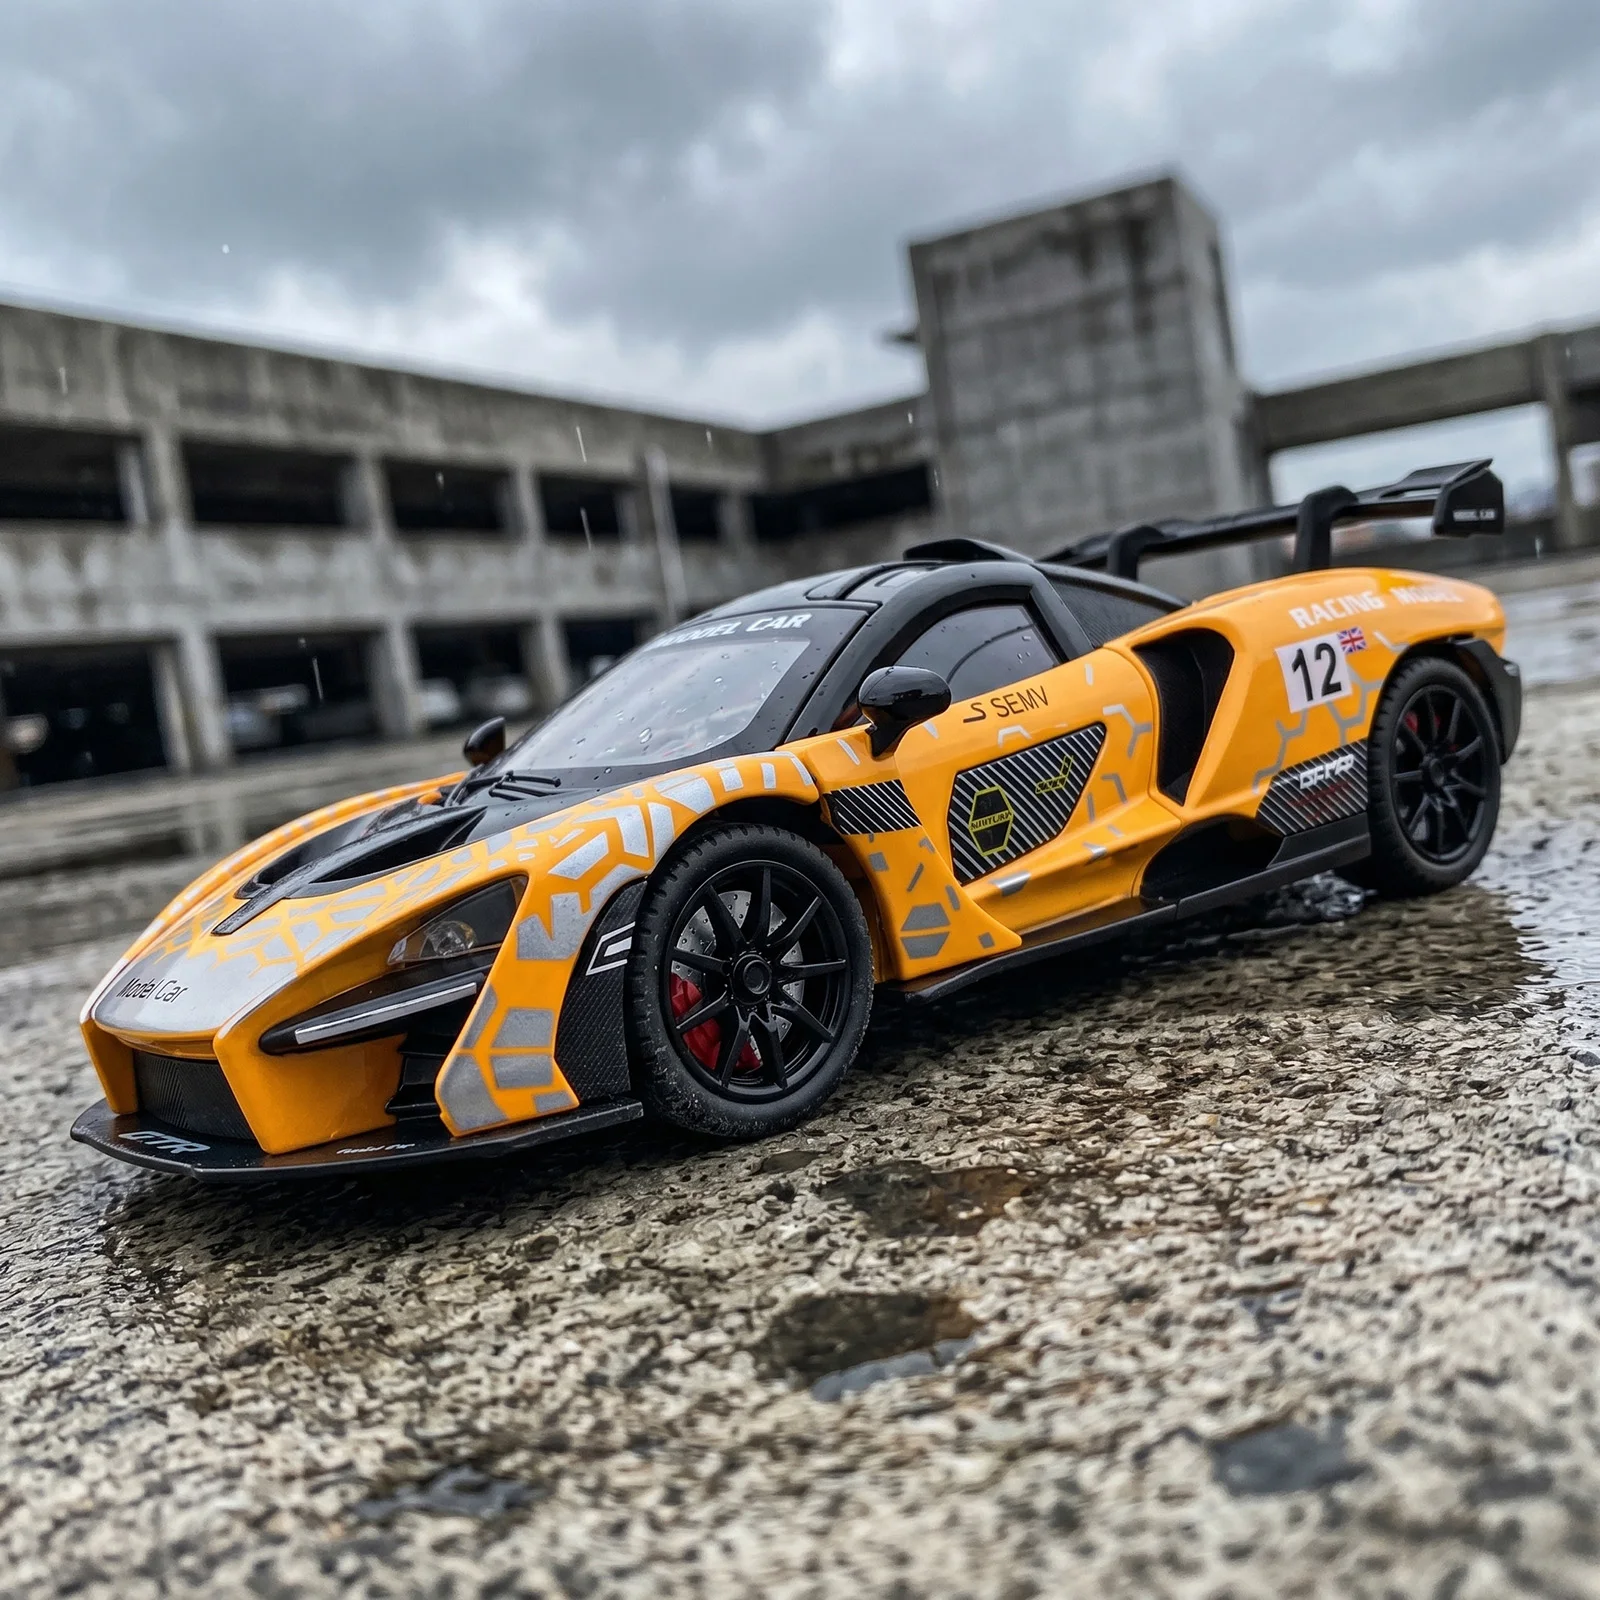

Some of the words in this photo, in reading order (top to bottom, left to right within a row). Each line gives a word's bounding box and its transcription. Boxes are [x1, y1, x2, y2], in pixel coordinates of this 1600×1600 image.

[745, 613, 813, 632] CAR
[1289, 590, 1385, 629] RACING
[1291, 642, 1342, 702] 12
[990, 685, 1048, 717] SEMV
[116, 977, 164, 999] Model
[155, 980, 189, 1003] Car
